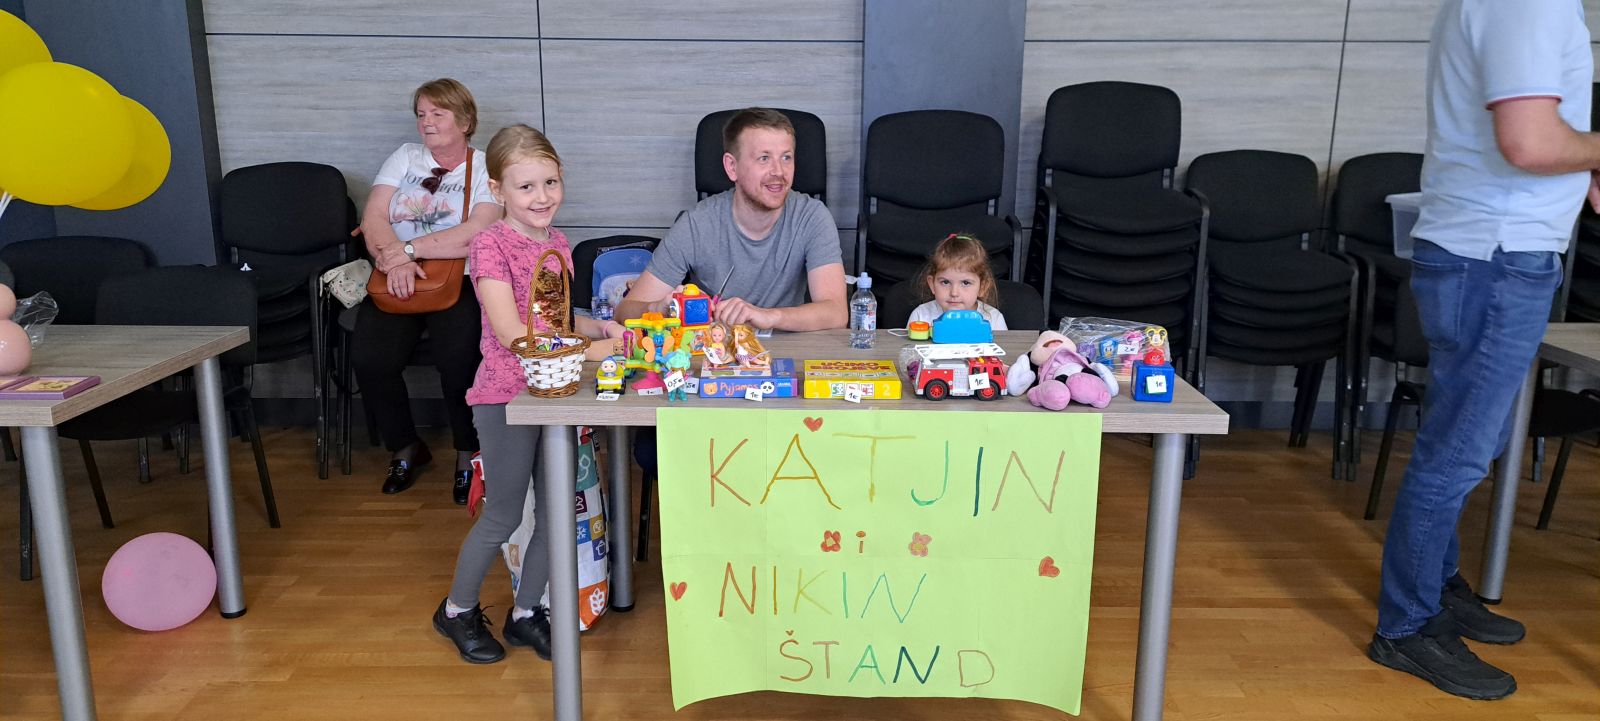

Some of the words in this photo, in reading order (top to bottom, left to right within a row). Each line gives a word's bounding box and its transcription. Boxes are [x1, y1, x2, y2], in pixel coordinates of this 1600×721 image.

[709, 433, 1066, 516] KATJIN
[855, 530, 866, 554] i
[718, 562, 927, 623] NIKIN
[779, 630, 995, 687] ŠTAND
